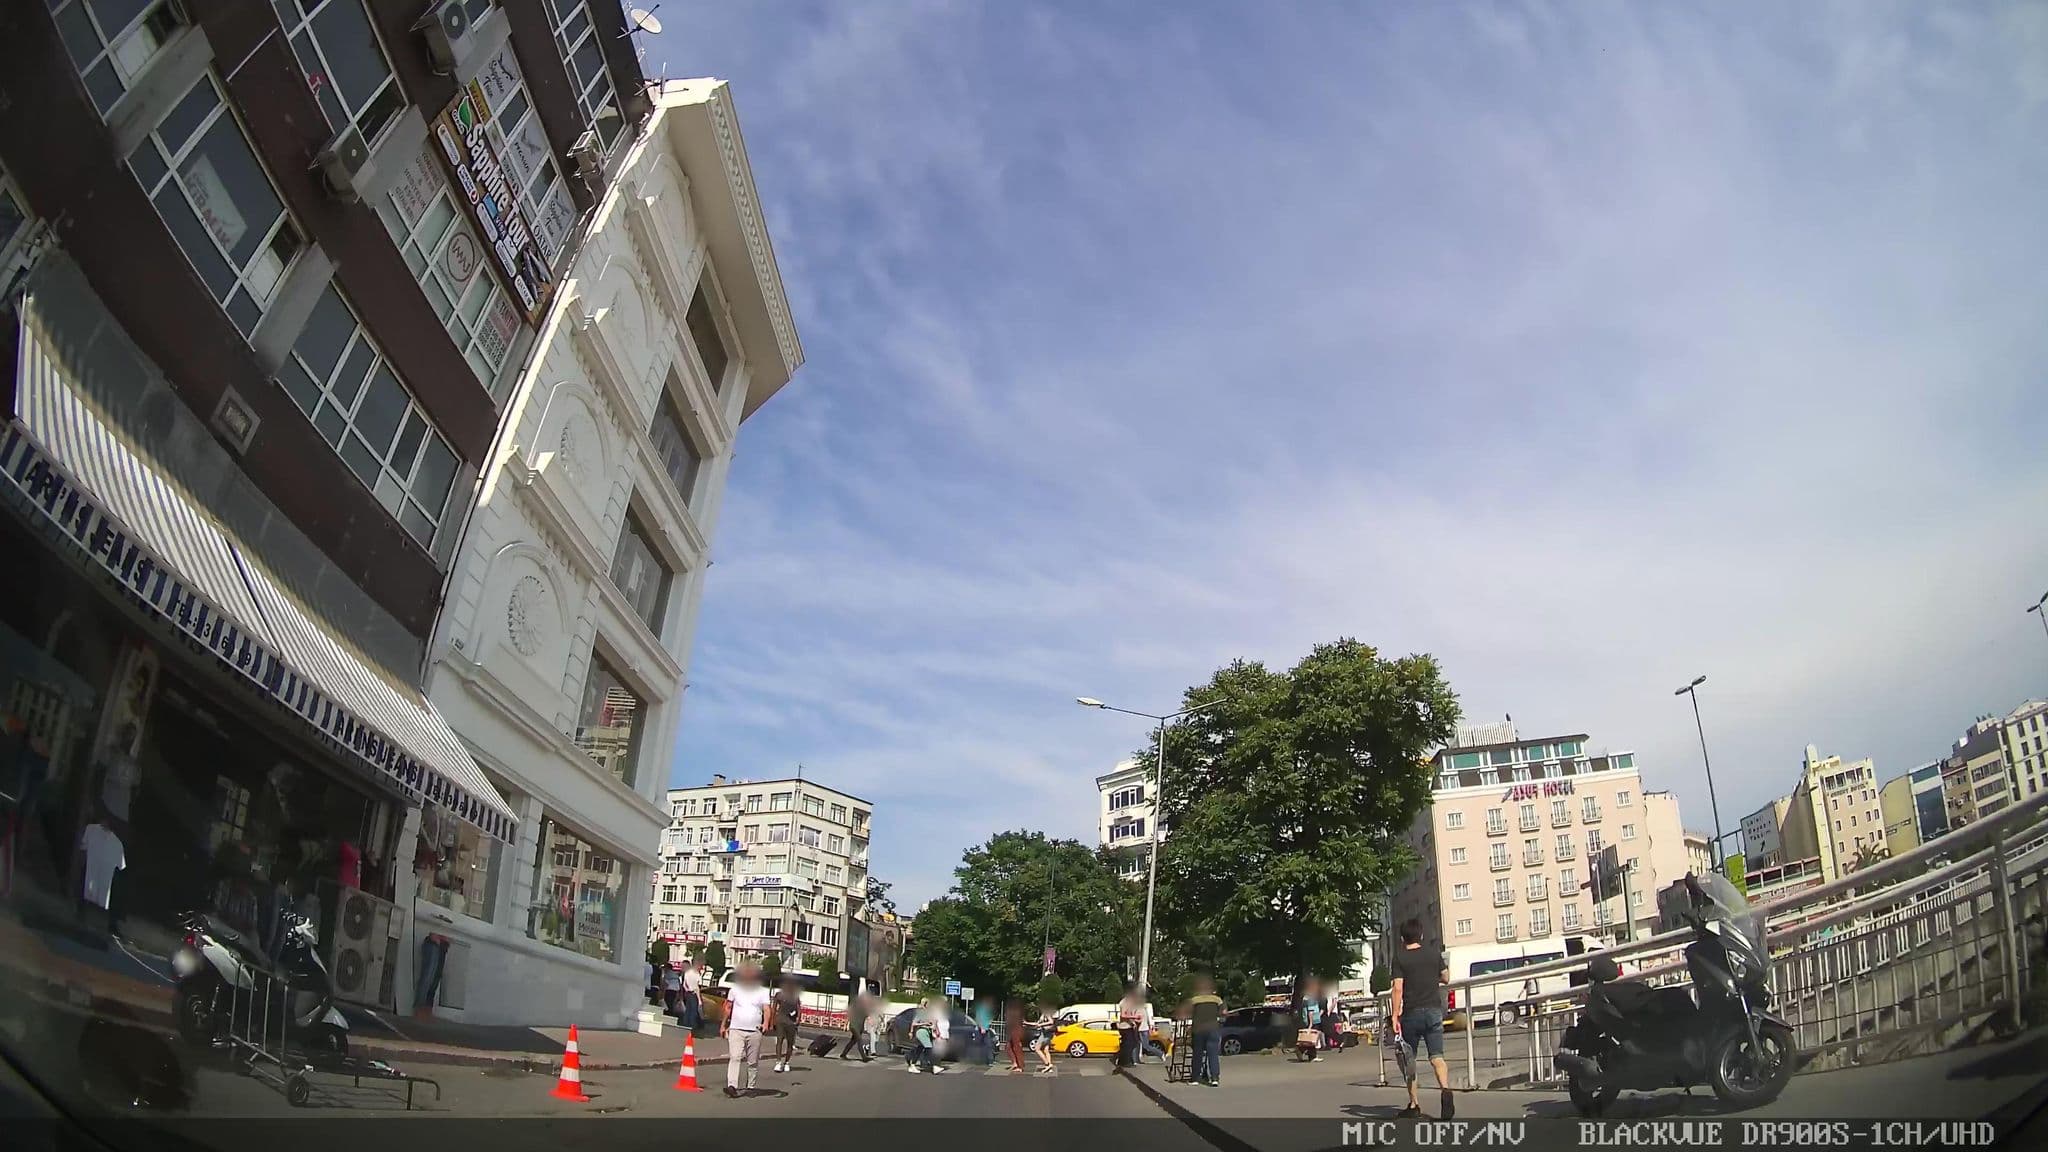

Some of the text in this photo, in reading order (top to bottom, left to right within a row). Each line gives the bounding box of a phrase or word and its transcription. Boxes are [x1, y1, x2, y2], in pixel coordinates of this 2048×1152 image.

[463, 122, 512, 212] Sapphire
[503, 202, 529, 251] Tour
[531, 224, 553, 261] QATAR
